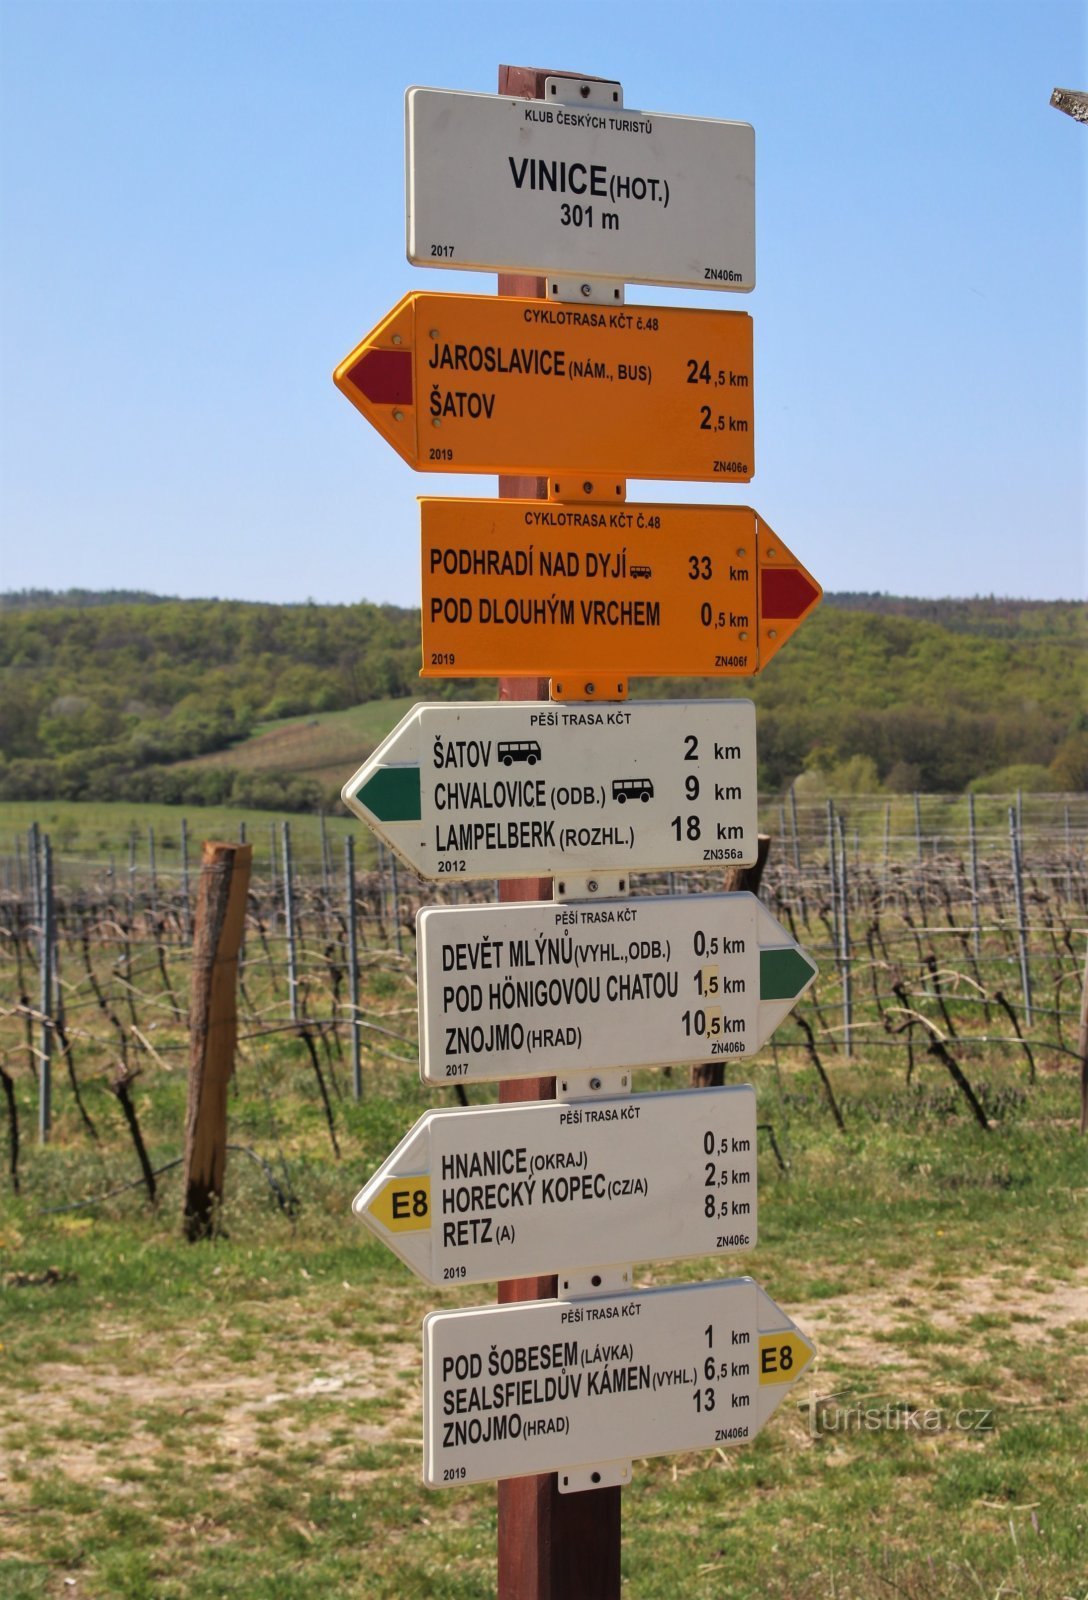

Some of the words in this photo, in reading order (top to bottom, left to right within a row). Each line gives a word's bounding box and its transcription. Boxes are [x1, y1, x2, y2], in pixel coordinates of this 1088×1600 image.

[525, 110, 553, 123] KLUB
[557, 111, 606, 129] ČESKÝCH
[609, 119, 652, 134] TURISTŮ
[561, 203, 592, 227] 301
[602, 213, 619, 230] m
[431, 245, 454, 257] 2017
[705, 268, 742, 281] ZN406m
[524, 309, 606, 327] CYKLOTRASA
[610, 313, 633, 328] KČT
[429, 344, 565, 376] JAROSLAVICE
[569, 359, 613, 381] (NÁM.,
[618, 364, 652, 385] BUS)
[730, 372, 748, 386] km
[430, 385, 495, 418] ŠATOV
[729, 417, 748, 431] km
[430, 448, 452, 460] 2019
[714, 461, 747, 473] ZN406e
[525, 512, 606, 527] CYKLOTRASA
[610, 512, 633, 528] KČT
[637, 513, 660, 529] Č.48
[431, 545, 533, 575] PODHRADÍ
[540, 552, 579, 576] NAD
[586, 548, 626, 578] DYJÍ
[689, 556, 712, 580] 33
[730, 566, 748, 580] km
[431, 598, 472, 623] POD
[479, 594, 574, 624] DLOUHÝM
[582, 601, 660, 625] VRCHEM
[730, 613, 748, 627] km
[432, 654, 454, 664] 2019
[715, 656, 747, 666] ZN406f
[531, 713, 558, 726] PĚŠÍ
[562, 714, 603, 725] TRASA
[607, 714, 631, 724] KČT
[434, 735, 491, 768] ŠATOV
[684, 735, 698, 760] 2
[715, 743, 740, 759] km
[435, 780, 546, 810] CHVALOVICE
[551, 786, 605, 810] (ODB.)
[685, 775, 699, 801] 9
[715, 784, 741, 800] km
[436, 821, 555, 851] LAMPELBERK
[560, 827, 634, 851] (ROZHL.)
[672, 815, 701, 841] 18
[717, 823, 743, 839] km
[704, 849, 742, 860] ZN356a
[438, 860, 465, 872] 2012
[556, 911, 577, 925] PĚŠÍ
[581, 912, 614, 923] TRASA
[617, 908, 637, 921] KČT
[443, 936, 503, 971] DEVĚT
[724, 937, 744, 954] km
[444, 985, 482, 1013] POD
[489, 976, 600, 1010] HÖNIGOVOU
[607, 972, 678, 1001] CHATOU
[724, 977, 745, 993] km
[724, 1016, 745, 1033] km
[711, 1042, 745, 1054] ZN406b
[446, 1064, 468, 1076] 2017
[560, 1110, 582, 1124] PĚŠÍ
[585, 1110, 618, 1122] TRASA
[621, 1106, 640, 1119] KČT
[732, 1138, 750, 1152] km
[443, 1173, 536, 1214] HORECKÝ
[732, 1170, 749, 1184] km
[392, 1190, 428, 1219] E8
[732, 1201, 750, 1215] km
[717, 1235, 749, 1247] ZN406c
[444, 1266, 466, 1279] 2019
[562, 1309, 583, 1323] PĚŠÍ
[586, 1307, 619, 1320] TRASA
[622, 1303, 641, 1316] KČT
[443, 1354, 482, 1382] POD
[705, 1325, 712, 1348] 1
[732, 1331, 749, 1344] km
[762, 1346, 793, 1373] E8
[443, 1368, 582, 1415] SEALSFIELDŮV
[732, 1363, 749, 1376] km
[693, 1388, 715, 1412] 13
[732, 1394, 749, 1407] km
[715, 1427, 748, 1441] ZN406d
[444, 1467, 466, 1480] 2019
